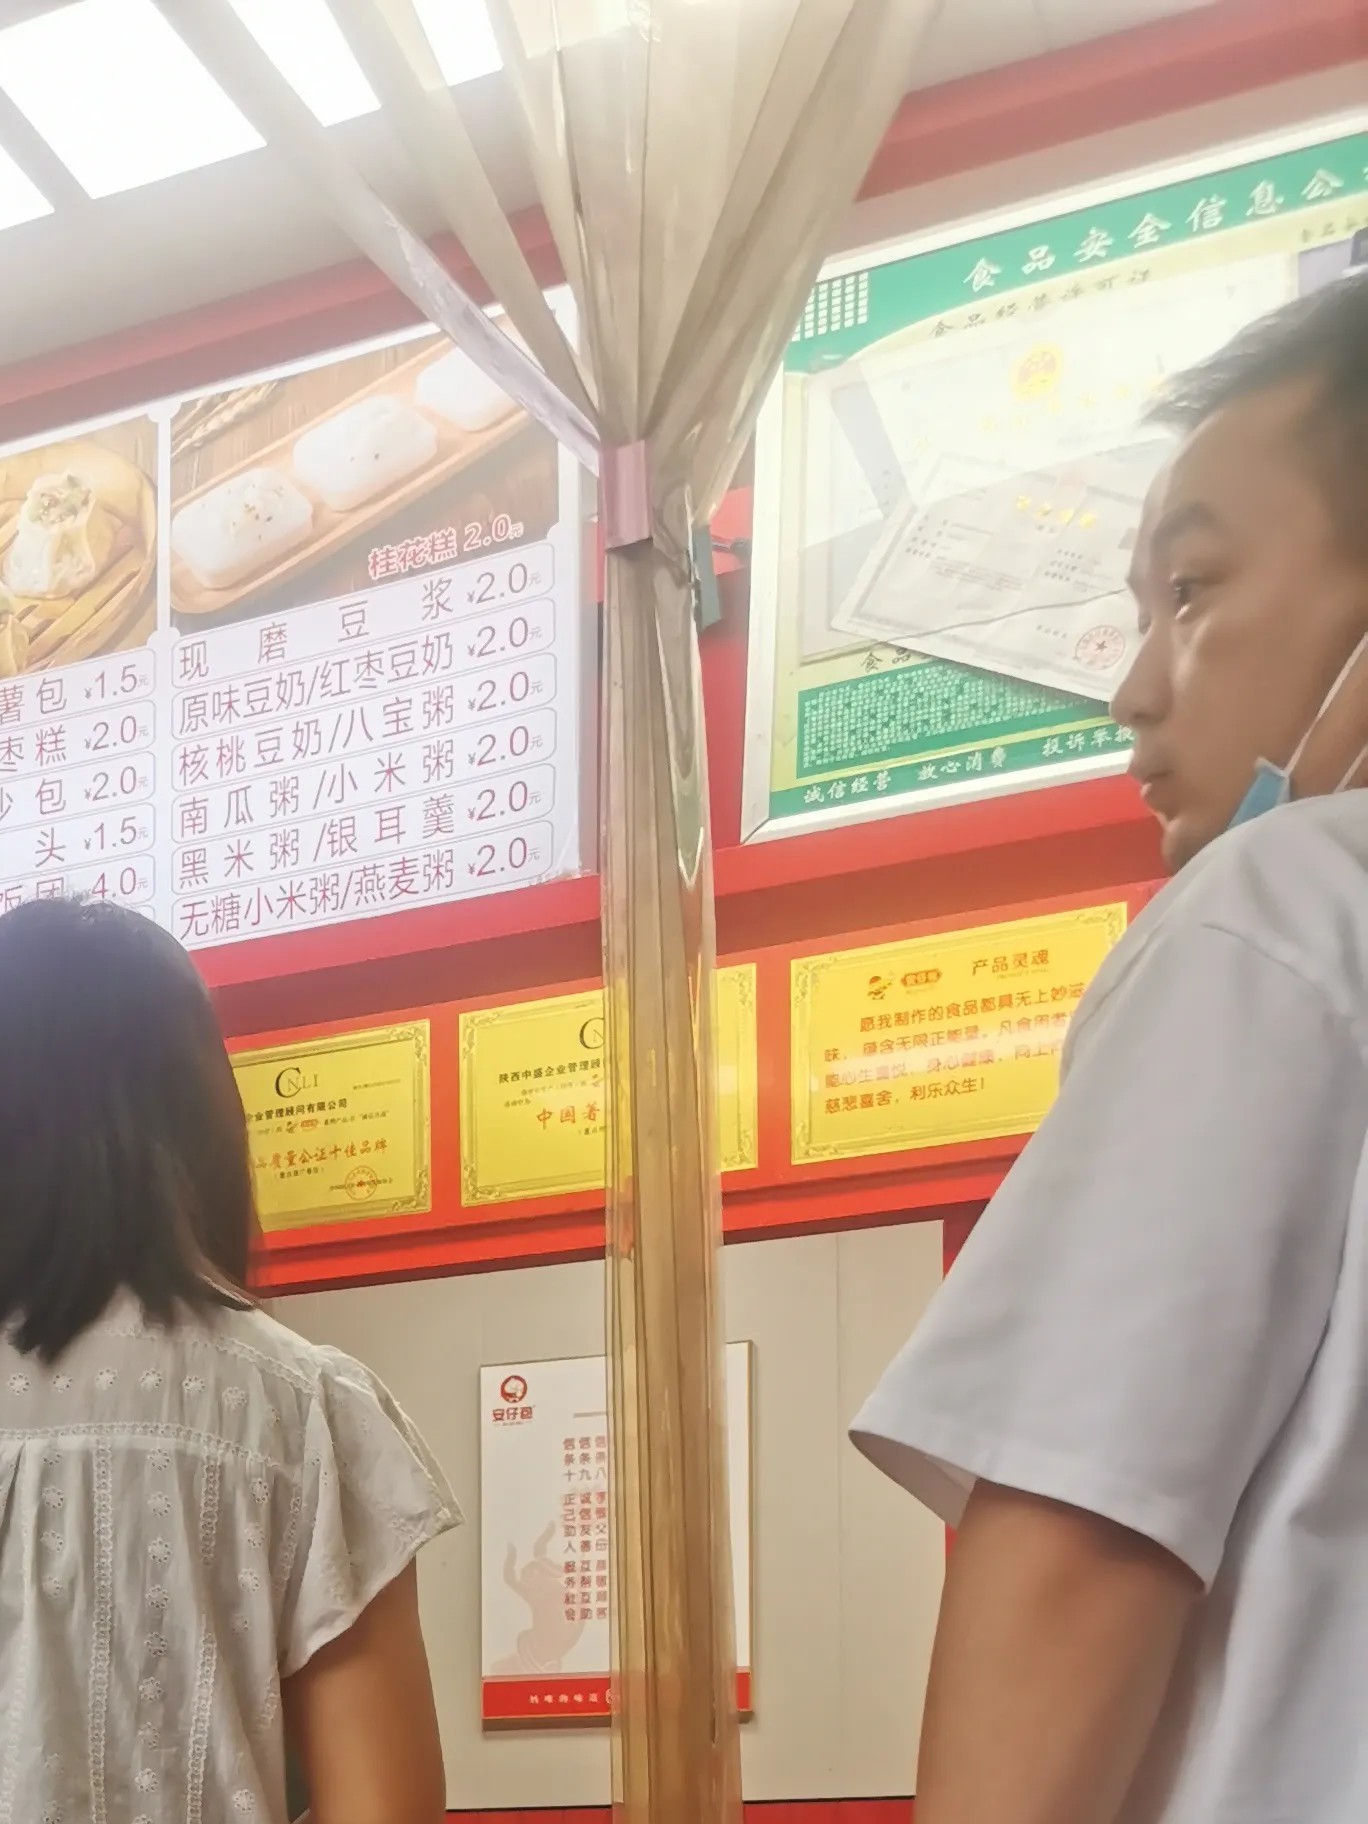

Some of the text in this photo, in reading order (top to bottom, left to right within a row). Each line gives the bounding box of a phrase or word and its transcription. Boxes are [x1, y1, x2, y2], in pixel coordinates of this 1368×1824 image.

[963, 167, 1368, 292] 食品安全信息公
[368, 528, 457, 579] 桂花糕
[180, 577, 454, 681] 现磨豆浆
[860, 646, 928, 674] 食品
[179, 632, 454, 735] 原味豆奶/红枣豆奶
[179, 685, 454, 787] 核桃豆奶/八宝粥
[180, 739, 454, 839] 南瓜粥/小米粥
[180, 794, 454, 888] 黑米粥/银耳羹
[179, 848, 454, 941] 无糖小米粥/燕麦粥
[971, 949, 1050, 977] 产品灵魂
